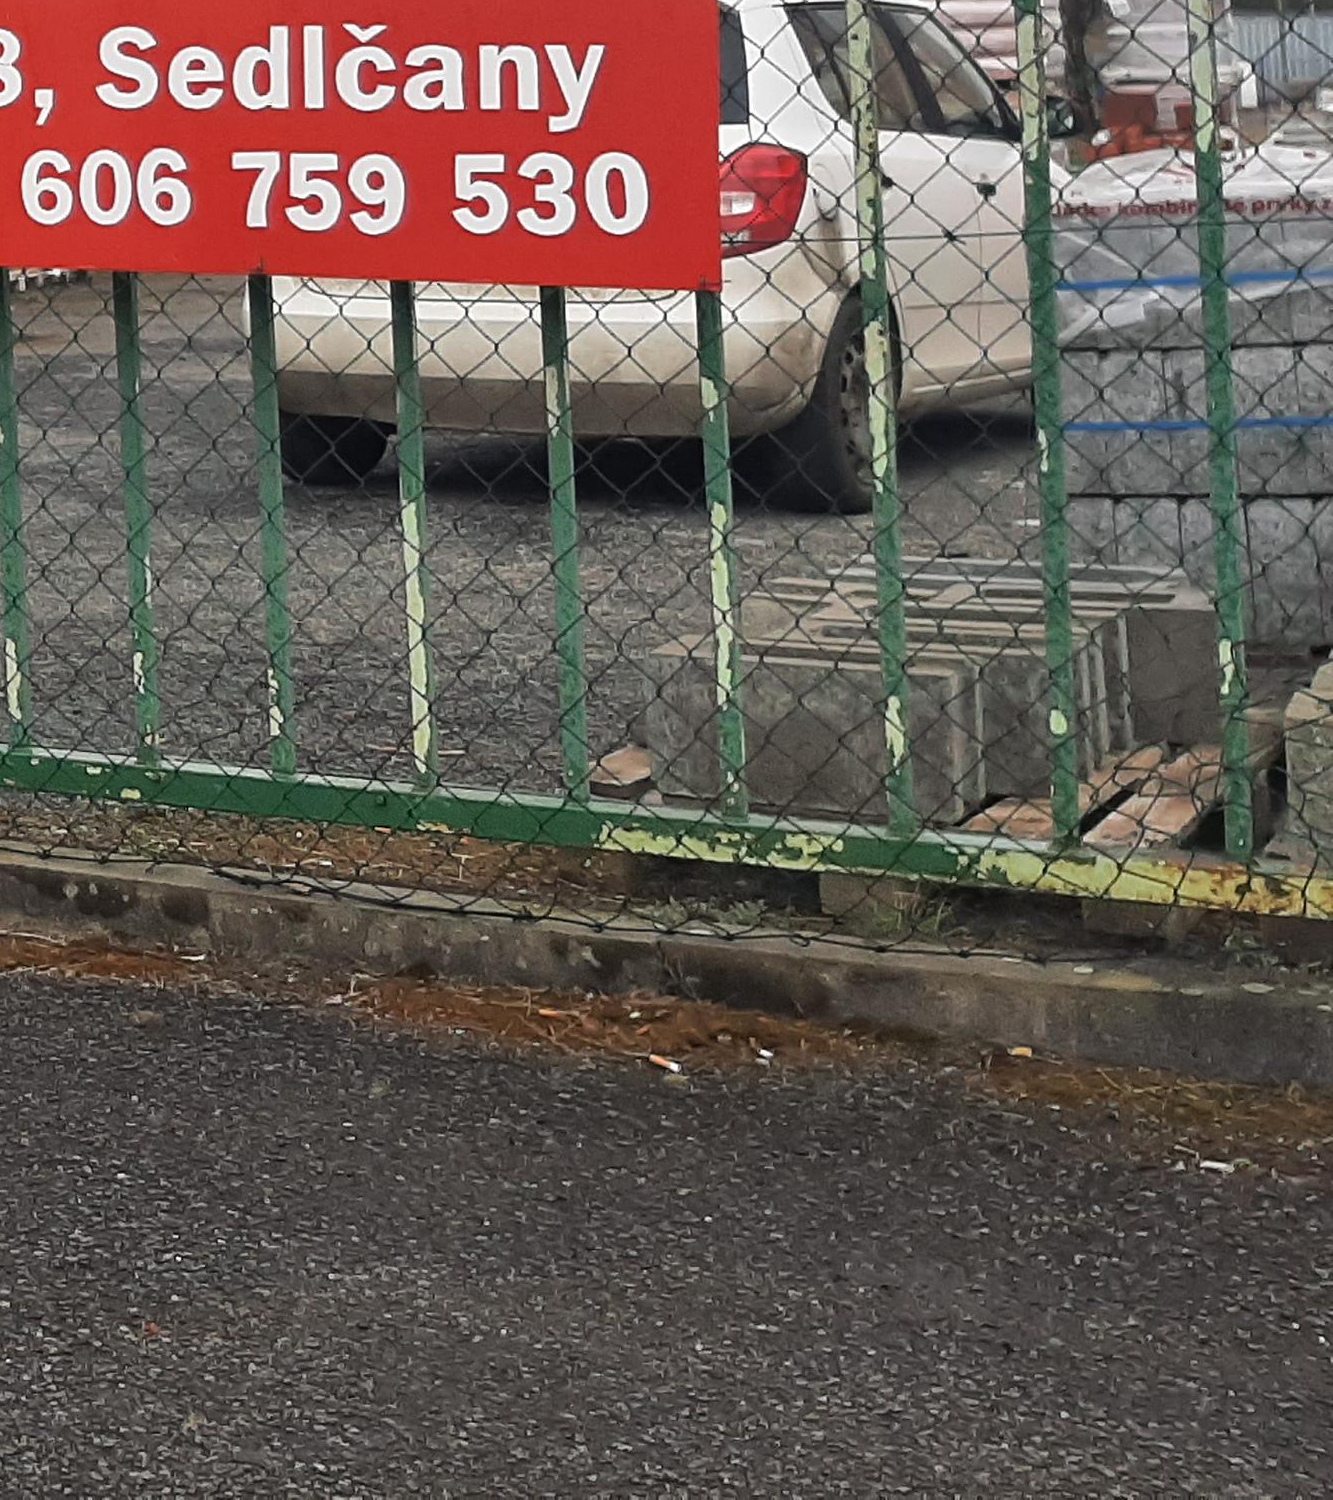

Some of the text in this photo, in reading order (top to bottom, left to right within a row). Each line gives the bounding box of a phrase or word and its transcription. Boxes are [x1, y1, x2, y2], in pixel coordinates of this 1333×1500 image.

[96, 24, 604, 132] Sedlčany
[22, 148, 191, 225] 606
[232, 152, 404, 235] 759
[453, 152, 648, 235] 530
